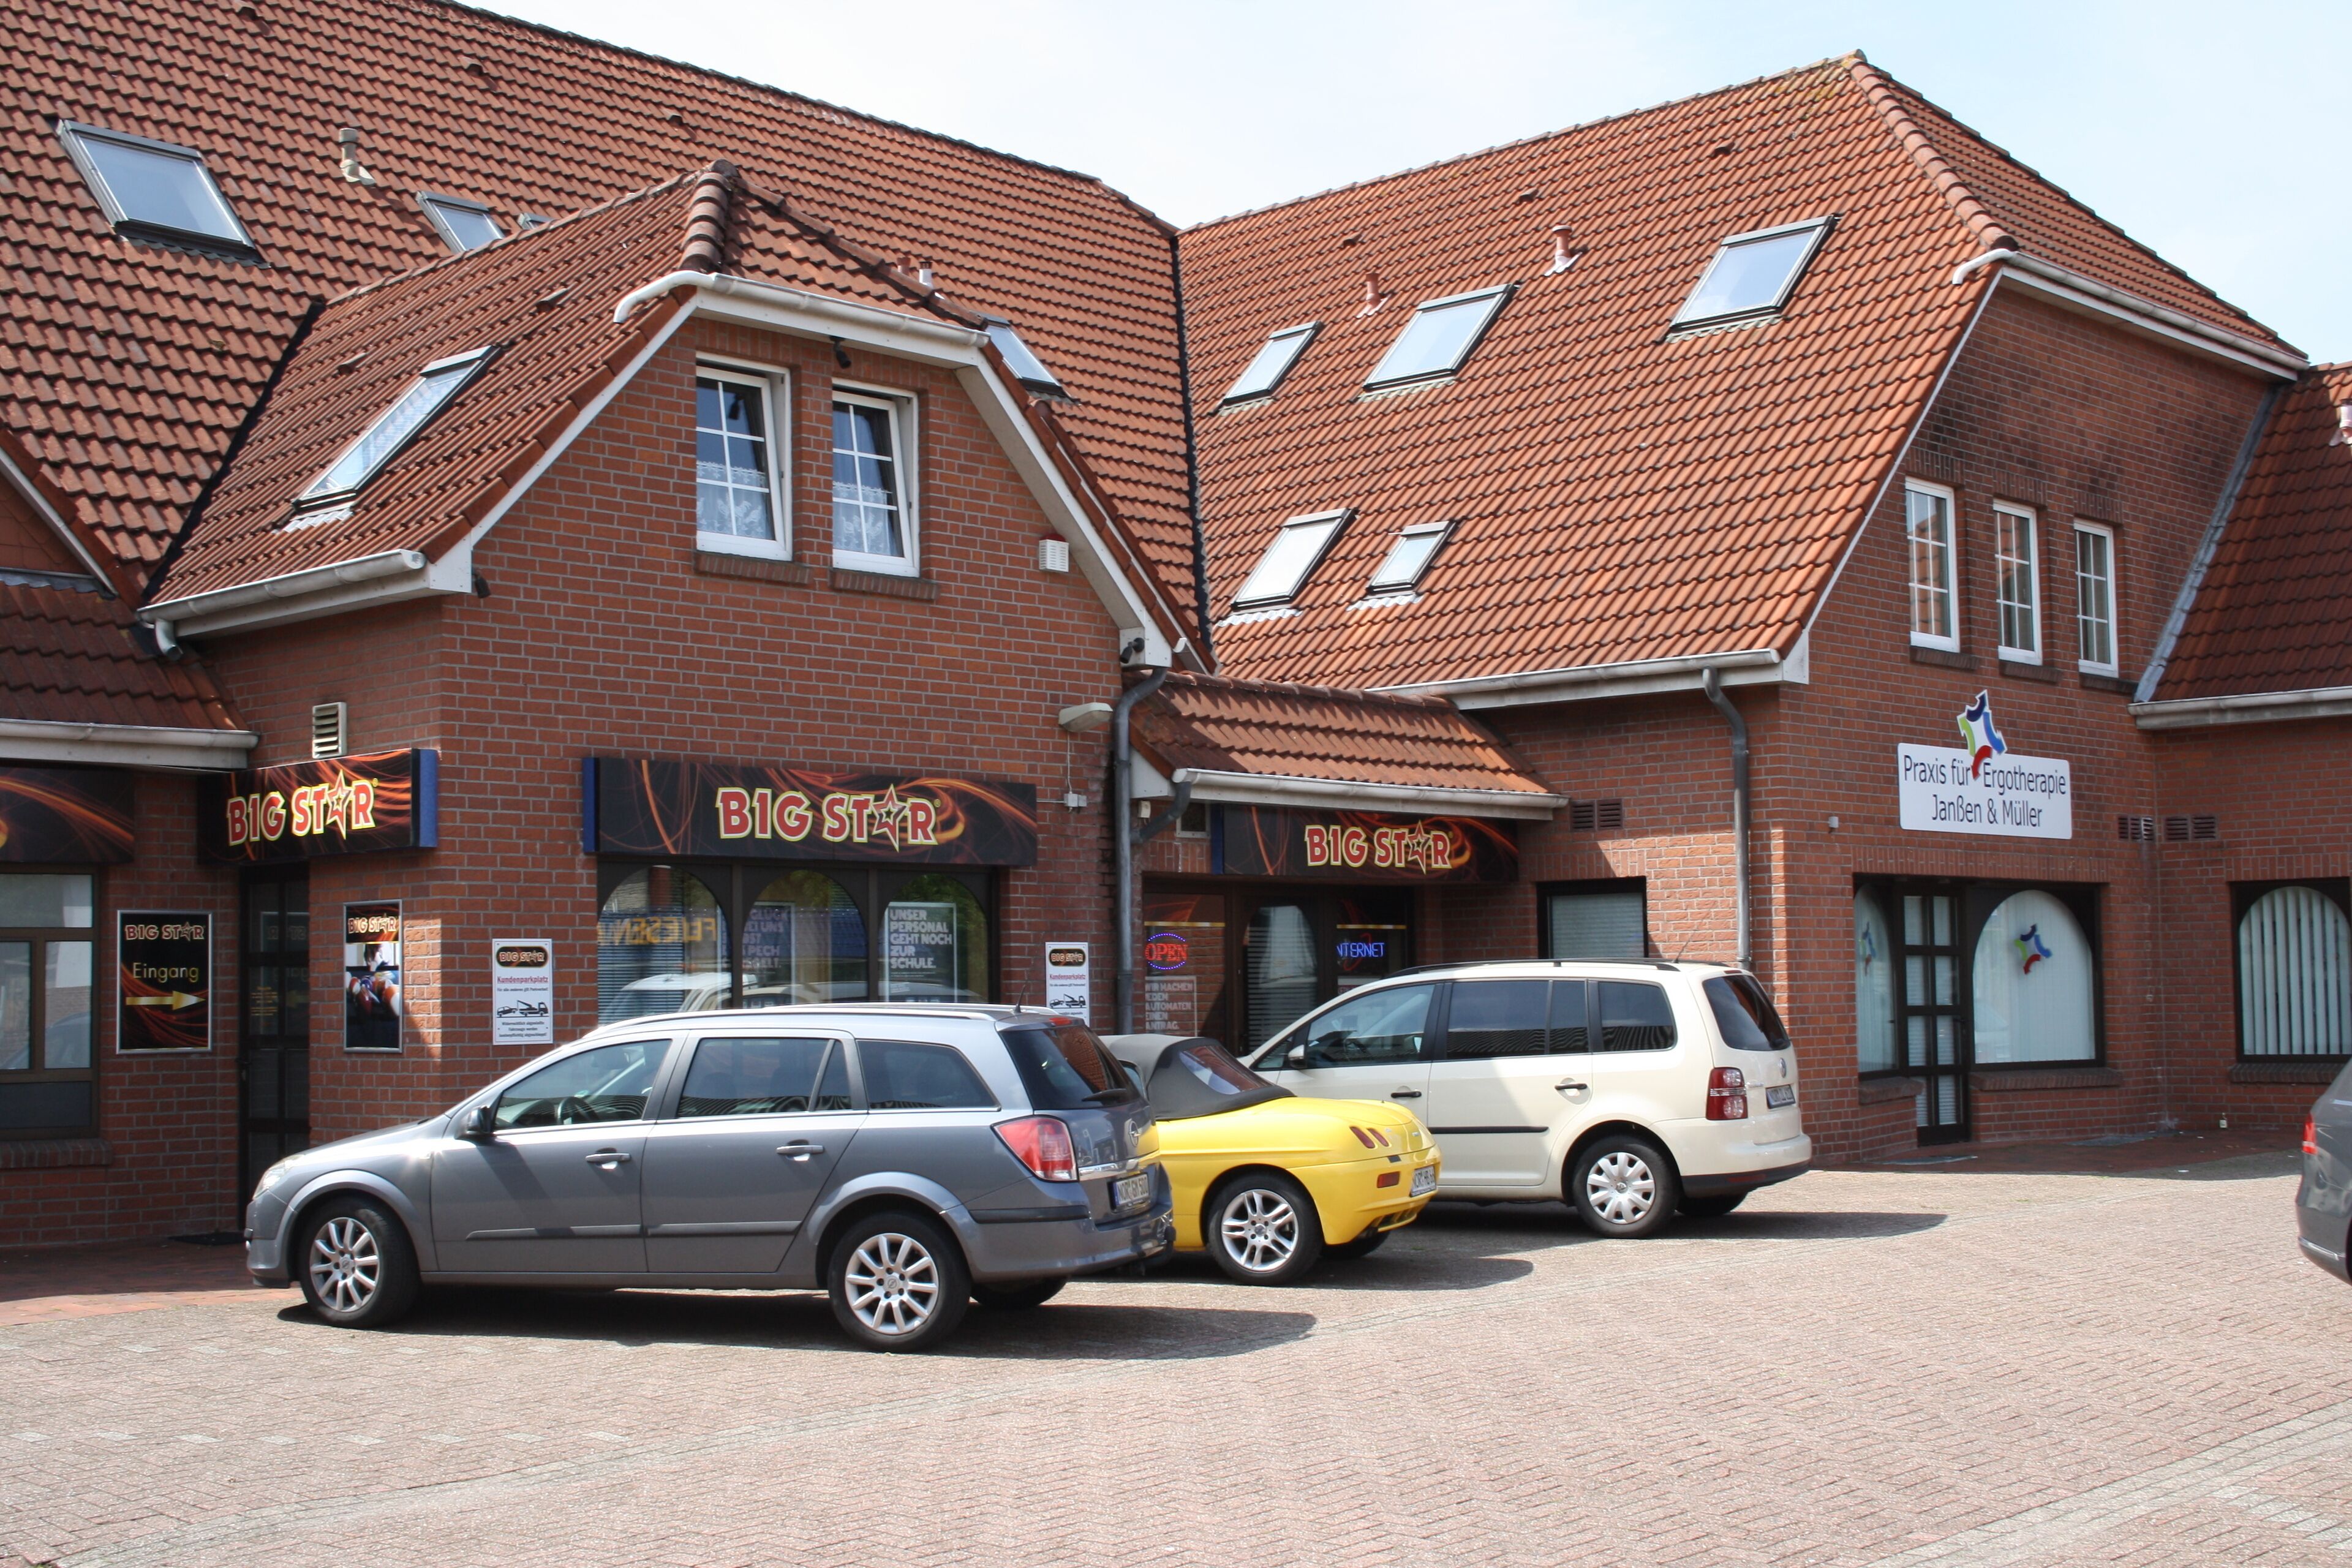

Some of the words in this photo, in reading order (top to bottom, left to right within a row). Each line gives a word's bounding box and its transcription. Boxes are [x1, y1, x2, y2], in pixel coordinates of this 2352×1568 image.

[1904, 755, 1946, 785] Praxis
[1951, 758, 1970, 786] für
[1983, 762, 2066, 799] Ergotherapie
[715, 787, 813, 842] BIG
[1932, 794, 1982, 823] Janßen
[1987, 798, 1998, 824] &
[2002, 800, 2042, 827] Müller
[227, 791, 286, 846] BIG
[1305, 824, 1368, 867] BIG
[890, 909, 927, 920] UNSER
[125, 924, 159, 940] BIG
[348, 917, 368, 934] BIG
[890, 921, 949, 932] PERSONAL
[890, 933, 919, 944] GEHT
[921, 933, 952, 944] NOCH
[499, 951, 519, 962] BIG
[747, 945, 780, 956] PECH
[890, 945, 916, 957] ZUR
[1145, 943, 1188, 961] OPEN
[1336, 943, 1384, 957] NTERNET
[890, 957, 936, 969] SCHULE.
[133, 962, 199, 983] Eingang
[1160, 982, 1193, 991] MACHEN
[1145, 1001, 1191, 1011] AUTOMATEN
